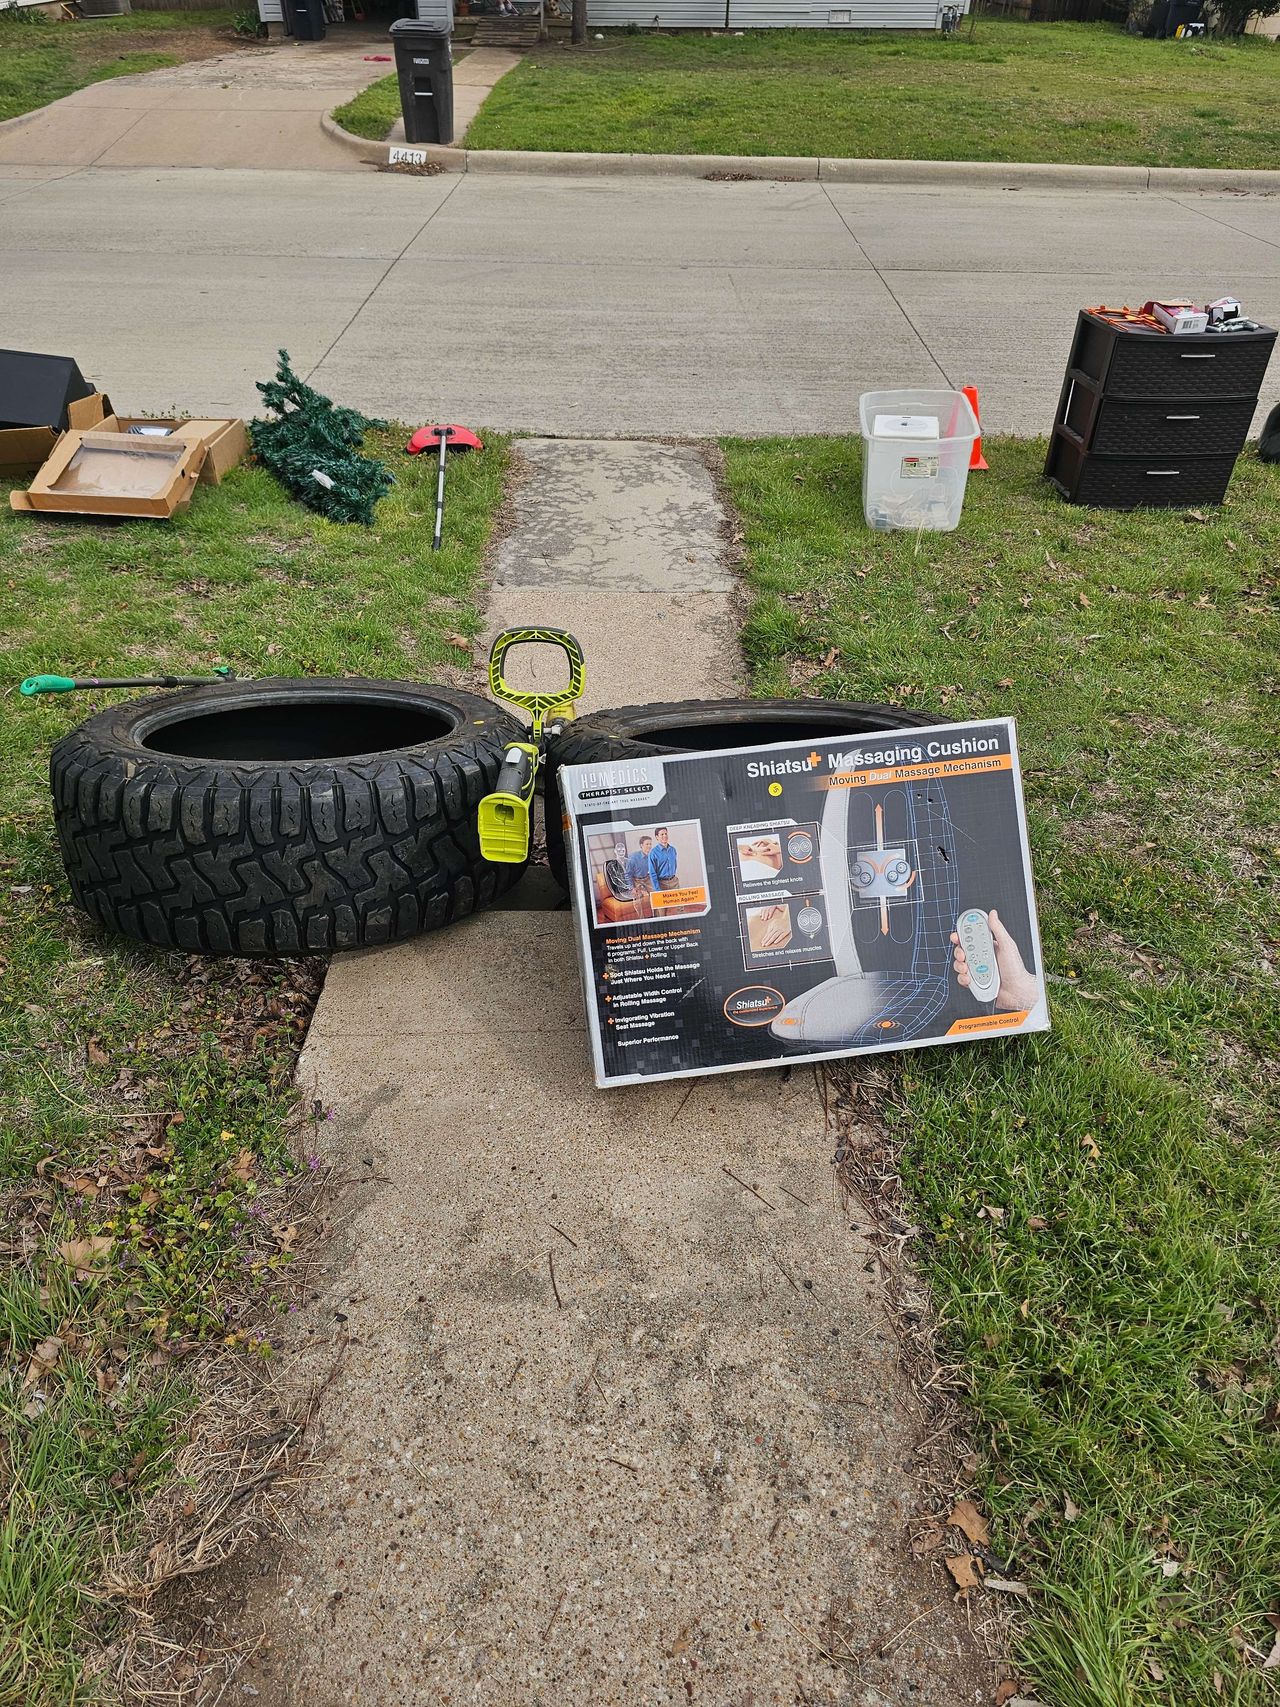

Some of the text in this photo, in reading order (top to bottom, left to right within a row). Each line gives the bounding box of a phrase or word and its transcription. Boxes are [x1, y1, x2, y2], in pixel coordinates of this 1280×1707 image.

[393, 150, 421, 164] 4413
[828, 744, 923, 768] Massaging
[927, 738, 999, 757] Cushion
[829, 758, 1001, 787] Moving Dual Massage Mechanism
[581, 785, 651, 798] THERAPIST SELECT
[642, 932, 668, 940] Massage
[668, 928, 701, 937] Mechanism
[609, 970, 624, 979] Spot
[624, 968, 645, 976] Shiatsu
[647, 966, 663, 974] Holds
[675, 962, 700, 971] Massage
[612, 992, 642, 1001] Adjustable
[661, 987, 682, 995] Control
[620, 999, 640, 1008] Rolling
[641, 997, 667, 1005] Massage
[615, 1011, 675, 1023] Invigorating Vibration
[958, 1017, 1019, 1030] Programmable Control
[616, 1021, 655, 1031] Seat Massage
[617, 1034, 679, 1047] Superior Performance
